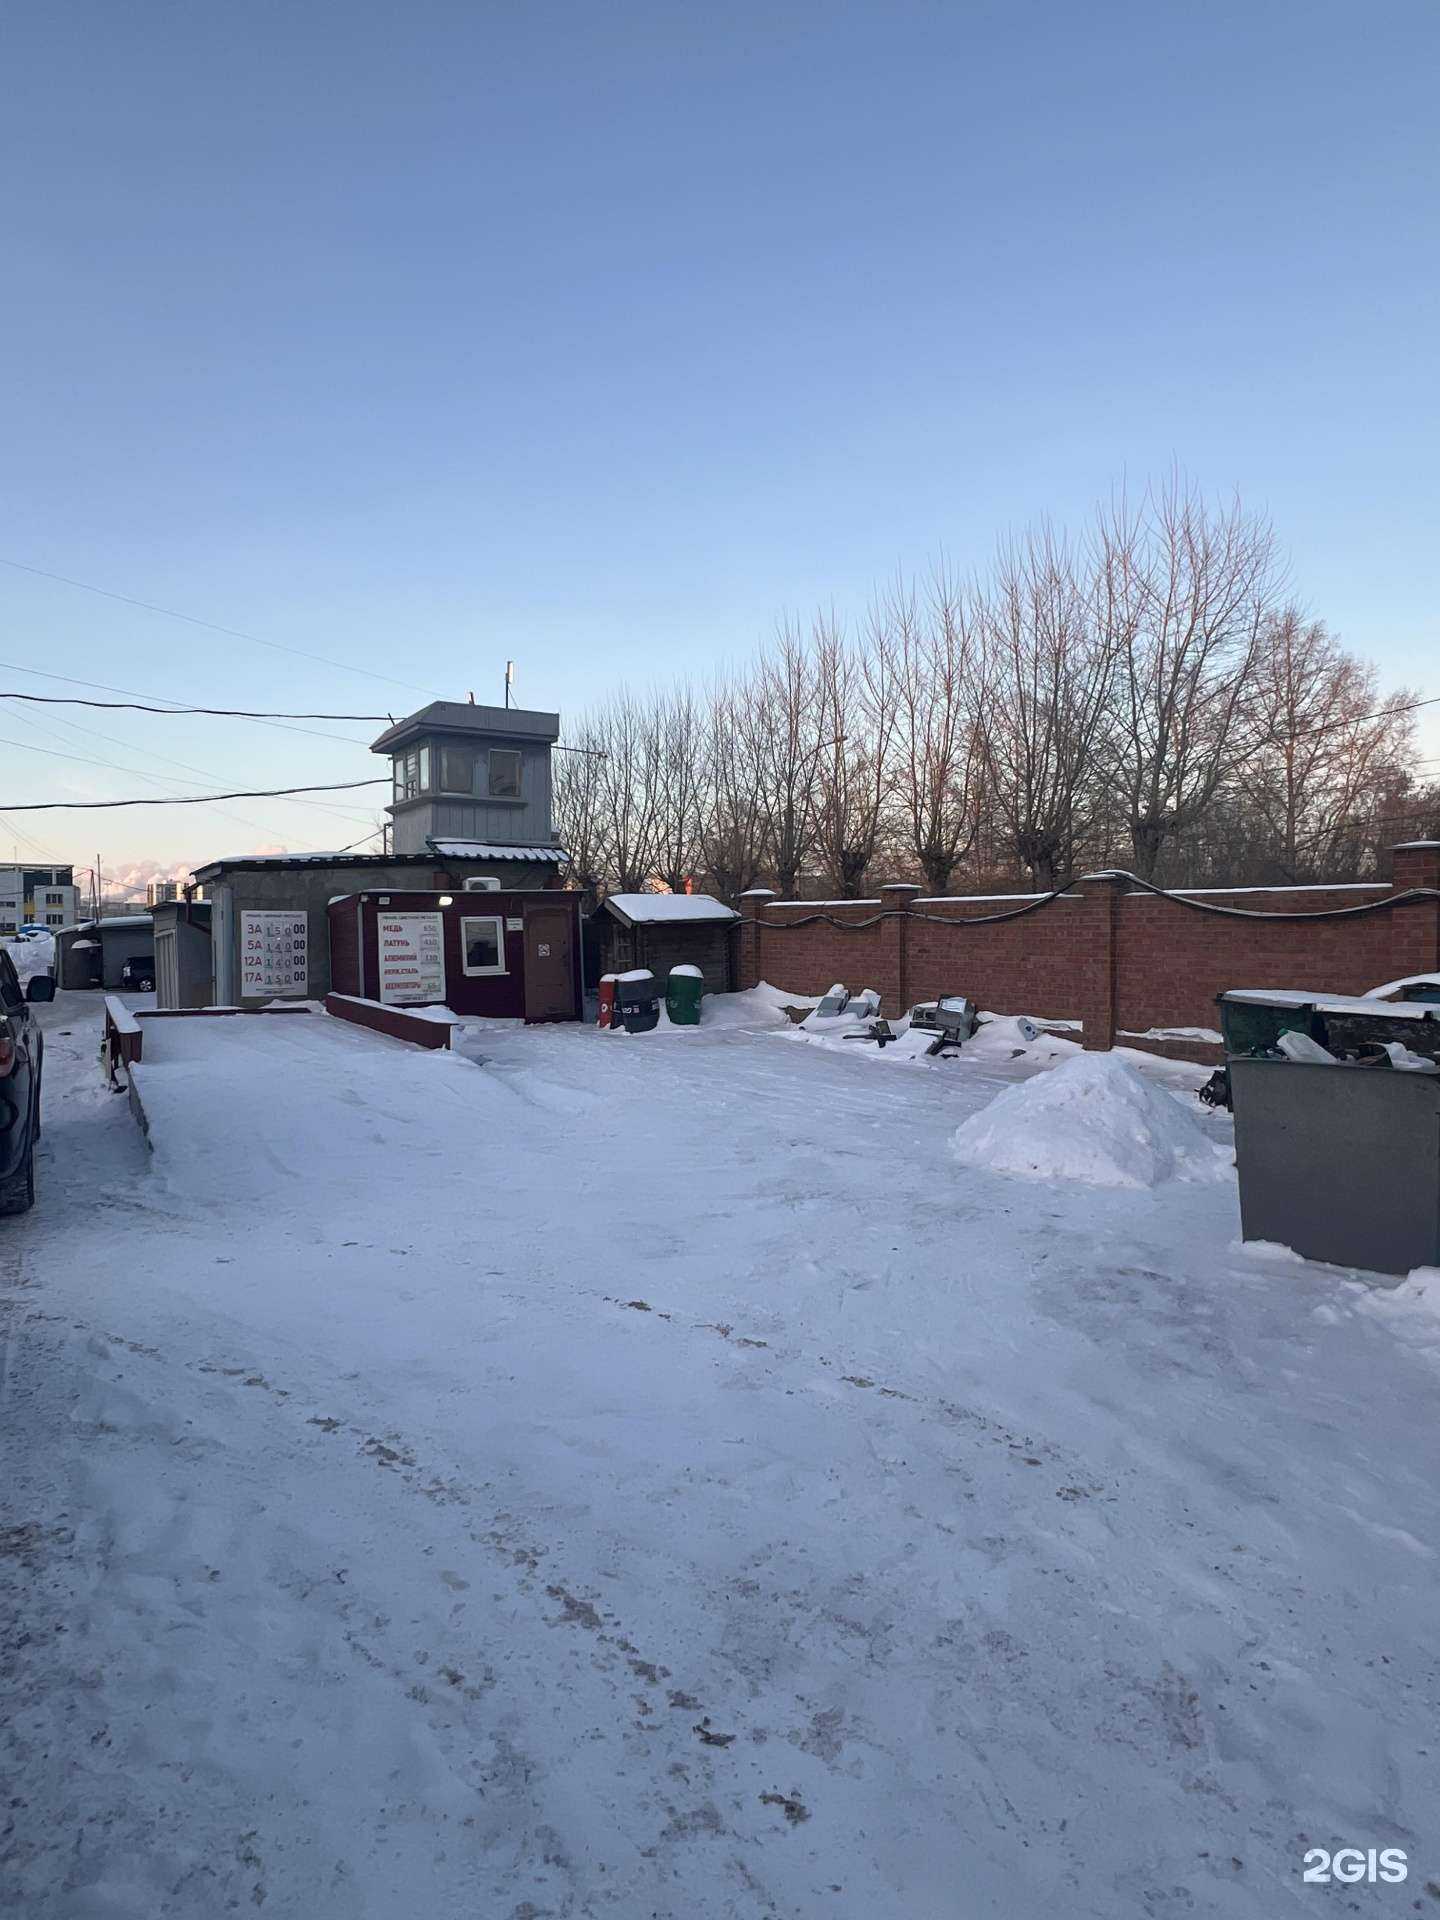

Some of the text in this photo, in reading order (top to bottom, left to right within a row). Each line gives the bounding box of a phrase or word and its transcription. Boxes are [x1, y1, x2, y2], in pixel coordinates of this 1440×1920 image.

[247, 924, 262, 934] 3А
[293, 924, 305, 934] 00
[247, 940, 262, 950] 5А
[293, 940, 305, 950] 00
[383, 939, 410, 947] ЛАТУНЬ
[244, 956, 262, 966] 12А
[293, 955, 305, 965] 00
[245, 972, 262, 982] 17А
[294, 971, 305, 981] 00
